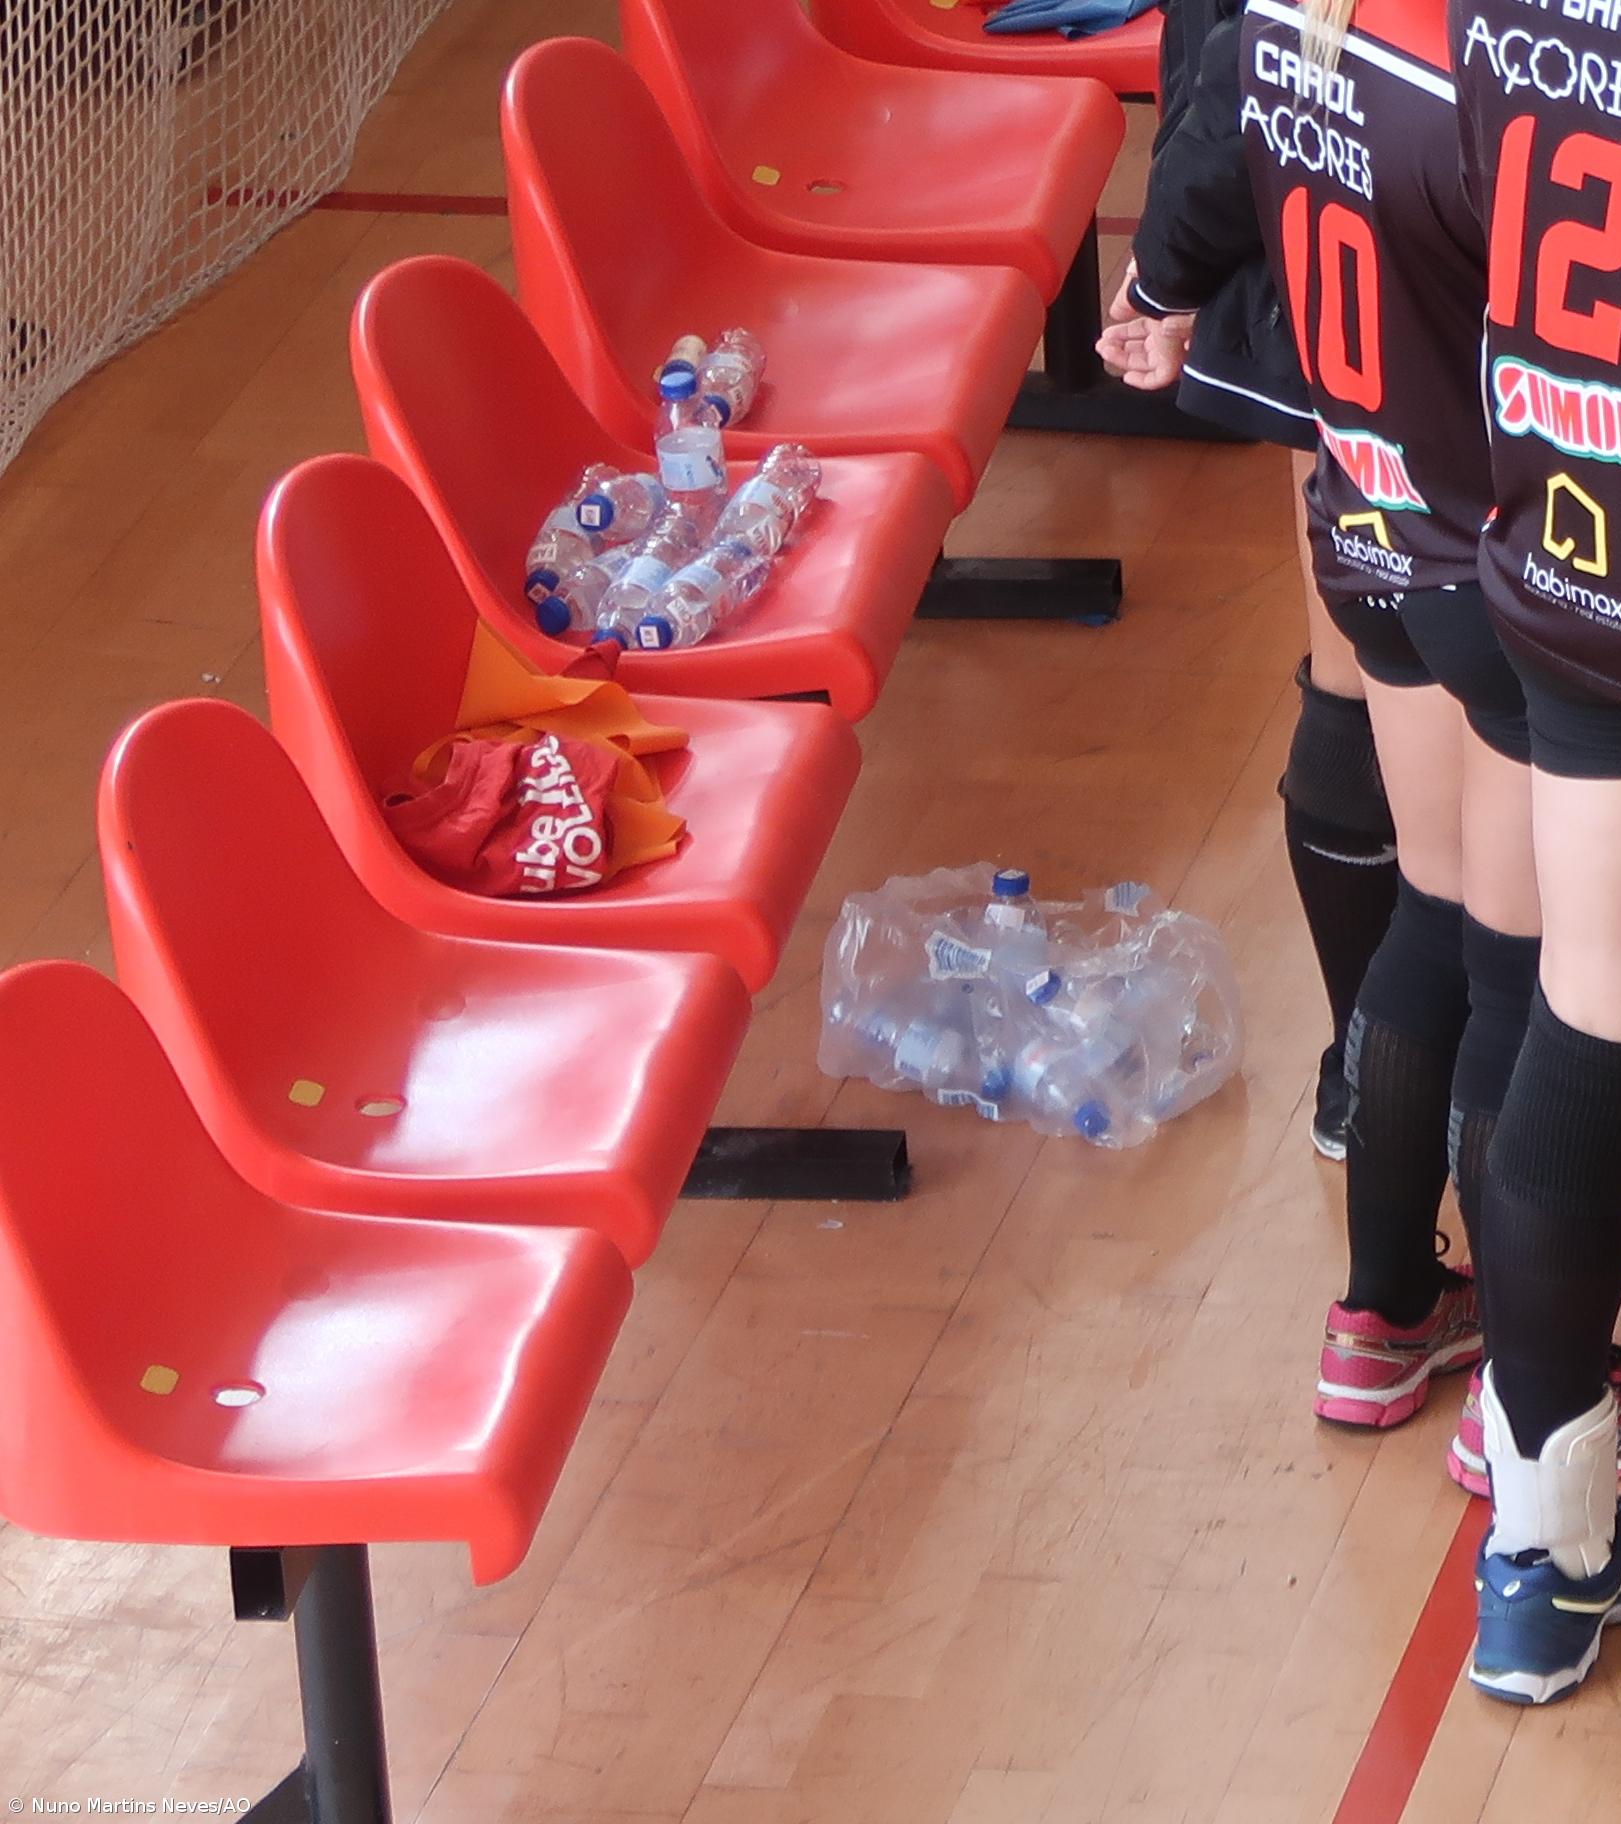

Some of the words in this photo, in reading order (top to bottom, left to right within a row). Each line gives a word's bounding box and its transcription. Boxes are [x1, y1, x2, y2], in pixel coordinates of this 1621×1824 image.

[1255, 39, 1365, 126] CAROL
[1241, 94, 1374, 201] AÇORES
[1281, 186, 1382, 413] 10
[1331, 526, 1413, 576] habimax
